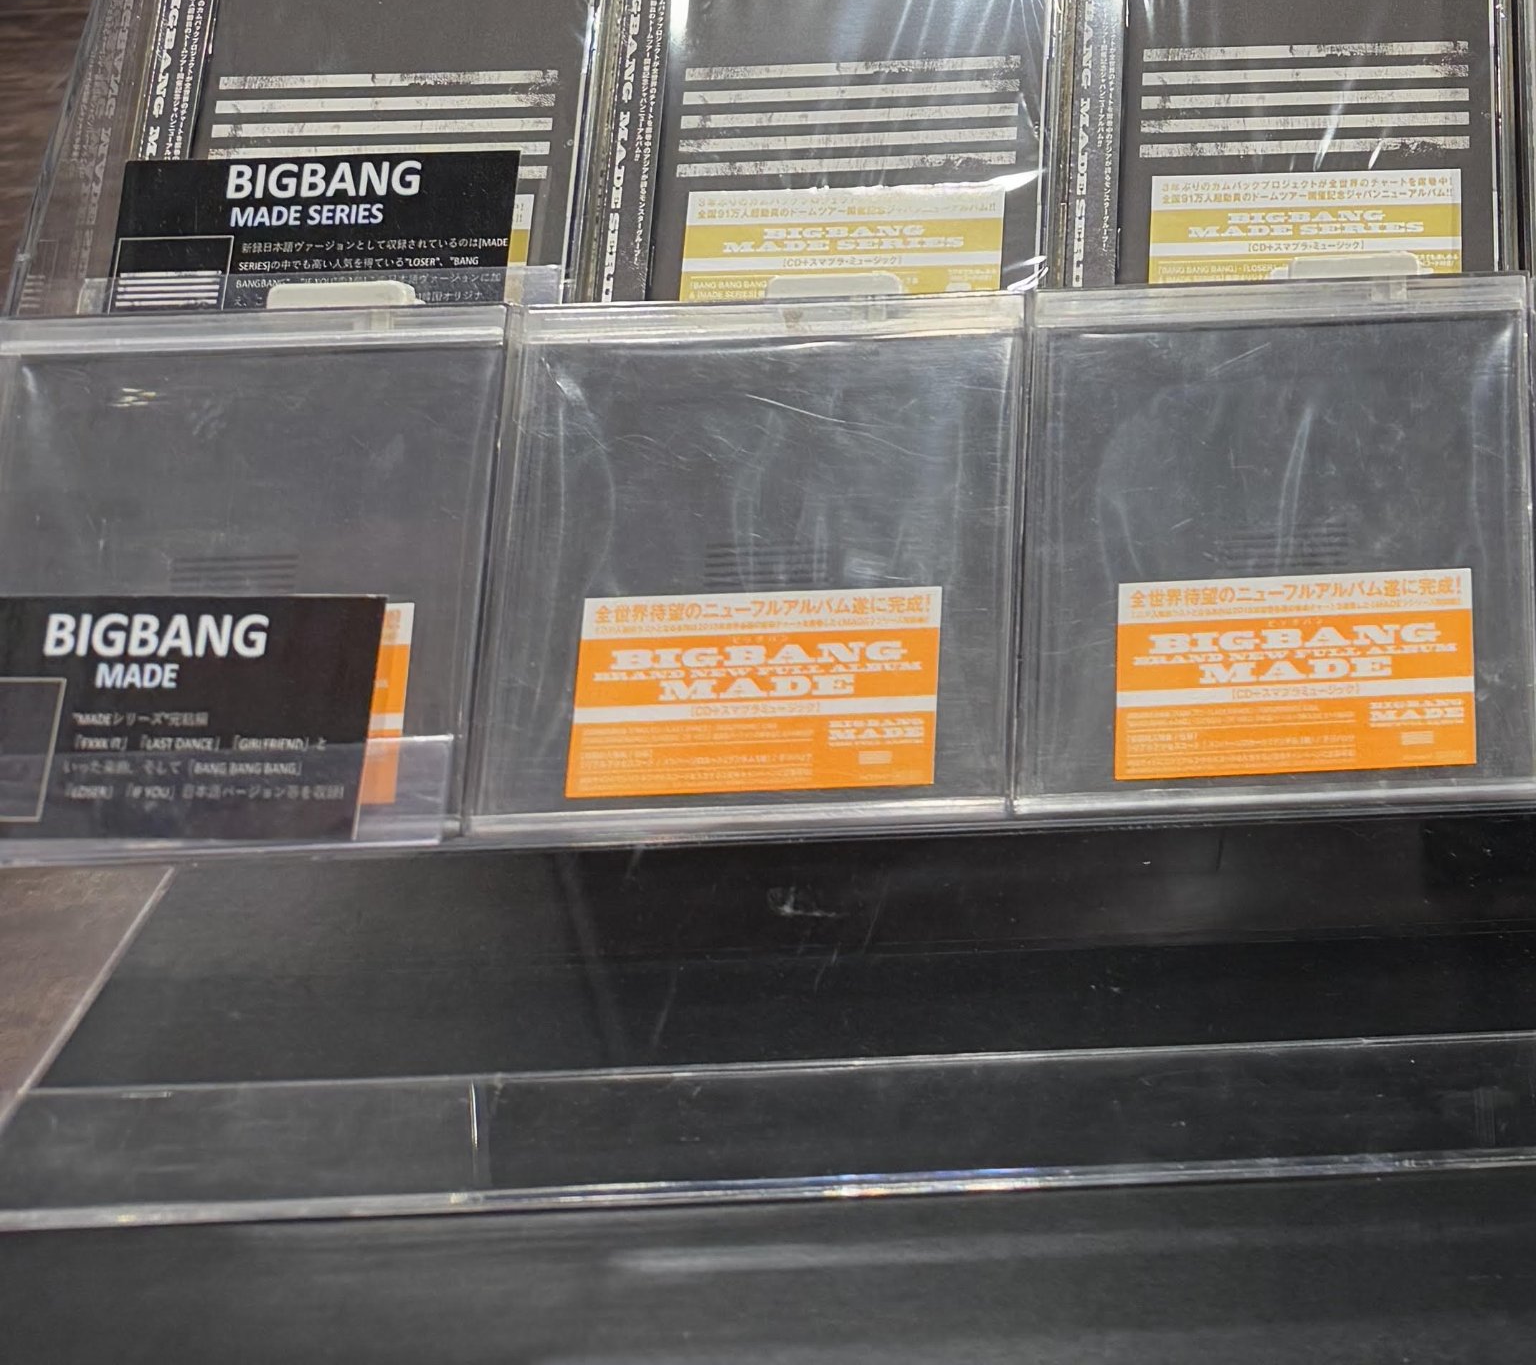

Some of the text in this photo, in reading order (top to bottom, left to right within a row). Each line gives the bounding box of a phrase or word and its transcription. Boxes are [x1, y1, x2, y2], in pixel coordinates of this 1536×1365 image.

[225, 159, 423, 201] BIGBANG
[230, 203, 385, 228] MADE SERIES
[1188, 221, 1425, 238] MADE SERIES
[1227, 209, 1386, 224] BIGBANG
[722, 236, 964, 253] MADE SERIES
[763, 225, 925, 240] BIGBANG
[43, 612, 270, 659] BIGBANG
[1147, 622, 1442, 655] BIGBANG
[609, 640, 908, 670] BIGBANG
[95, 662, 180, 689] MADE
[1199, 655, 1393, 684] MADE
[658, 673, 855, 702] MADE
